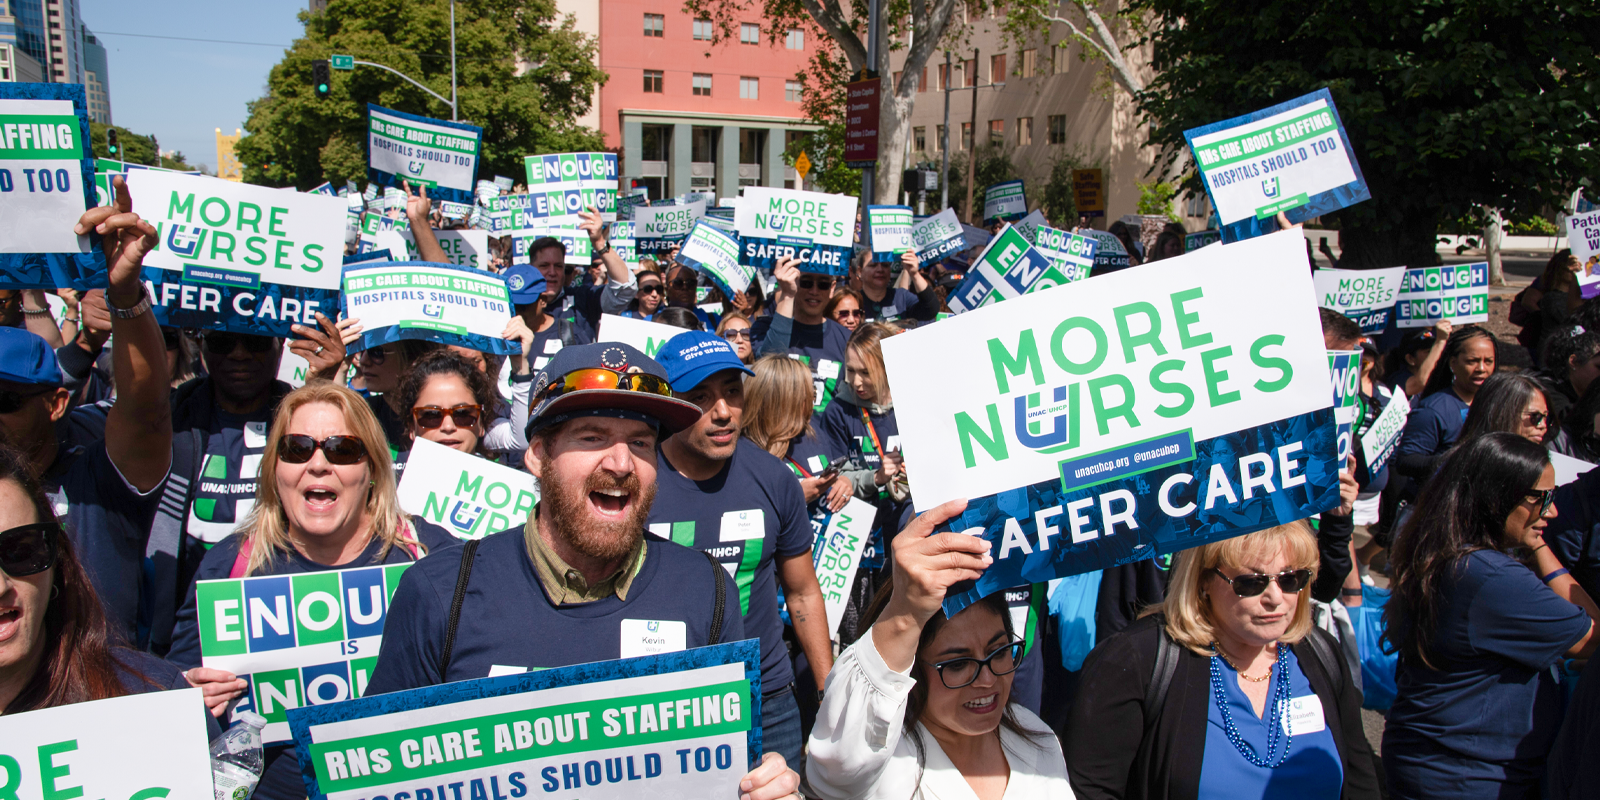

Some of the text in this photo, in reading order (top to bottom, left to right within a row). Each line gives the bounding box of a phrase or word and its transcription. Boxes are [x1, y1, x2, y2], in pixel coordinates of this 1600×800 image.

[371, 119, 475, 151] RNs CARE ABOUT STAFFING
[1199, 112, 1332, 166] RNs CARE ABOUT STAFFING
[373, 137, 470, 167] HOSPITALS SHOULD TOO
[1211, 136, 1337, 189] HOSPITALS SHOULD TOO
[22, 168, 70, 192] TOO
[531, 159, 615, 180] ENOUGH
[167, 190, 289, 237] MORE
[536, 193, 615, 214] ENOUGH
[768, 197, 828, 219] MORE
[655, 209, 692, 223] MORE
[755, 213, 844, 237] NURSES
[911, 218, 940, 238] MORE
[874, 227, 902, 235] HOSPITALS
[1037, 230, 1093, 256] ENOUGH
[692, 238, 724, 258] HOSPITALS
[746, 243, 842, 266] SAFER CARE
[939, 236, 964, 253] CARE
[348, 274, 506, 298] RNs CARE ABOUT STAFFING
[1338, 276, 1385, 292] MORE
[232, 292, 320, 325] CARE
[354, 290, 505, 313] HOSPITALS SHOULD TOO
[1325, 288, 1394, 307] NURSES
[1401, 297, 1484, 317] ENOUGH
[1359, 312, 1387, 328] CARE
[679, 345, 699, 357] Keep
[986, 286, 1214, 395] MORE
[685, 351, 704, 361] Give
[953, 333, 1293, 469] NURSES
[1372, 404, 1408, 454] NURSES
[1375, 403, 1399, 439] MORE
[1074, 443, 1180, 479] unacuhcp.org @unacuhcp
[1371, 444, 1395, 474] SAFER
[960, 440, 1307, 560] AFER CARE
[828, 534, 860, 604] MORE
[340, 640, 359, 656] IS
[642, 636, 666, 645] Kevin
[323, 691, 742, 782] RNs CARE ABOUT STAFFING
[541, 752, 662, 794] SHOULD
[675, 743, 733, 775] TOO
